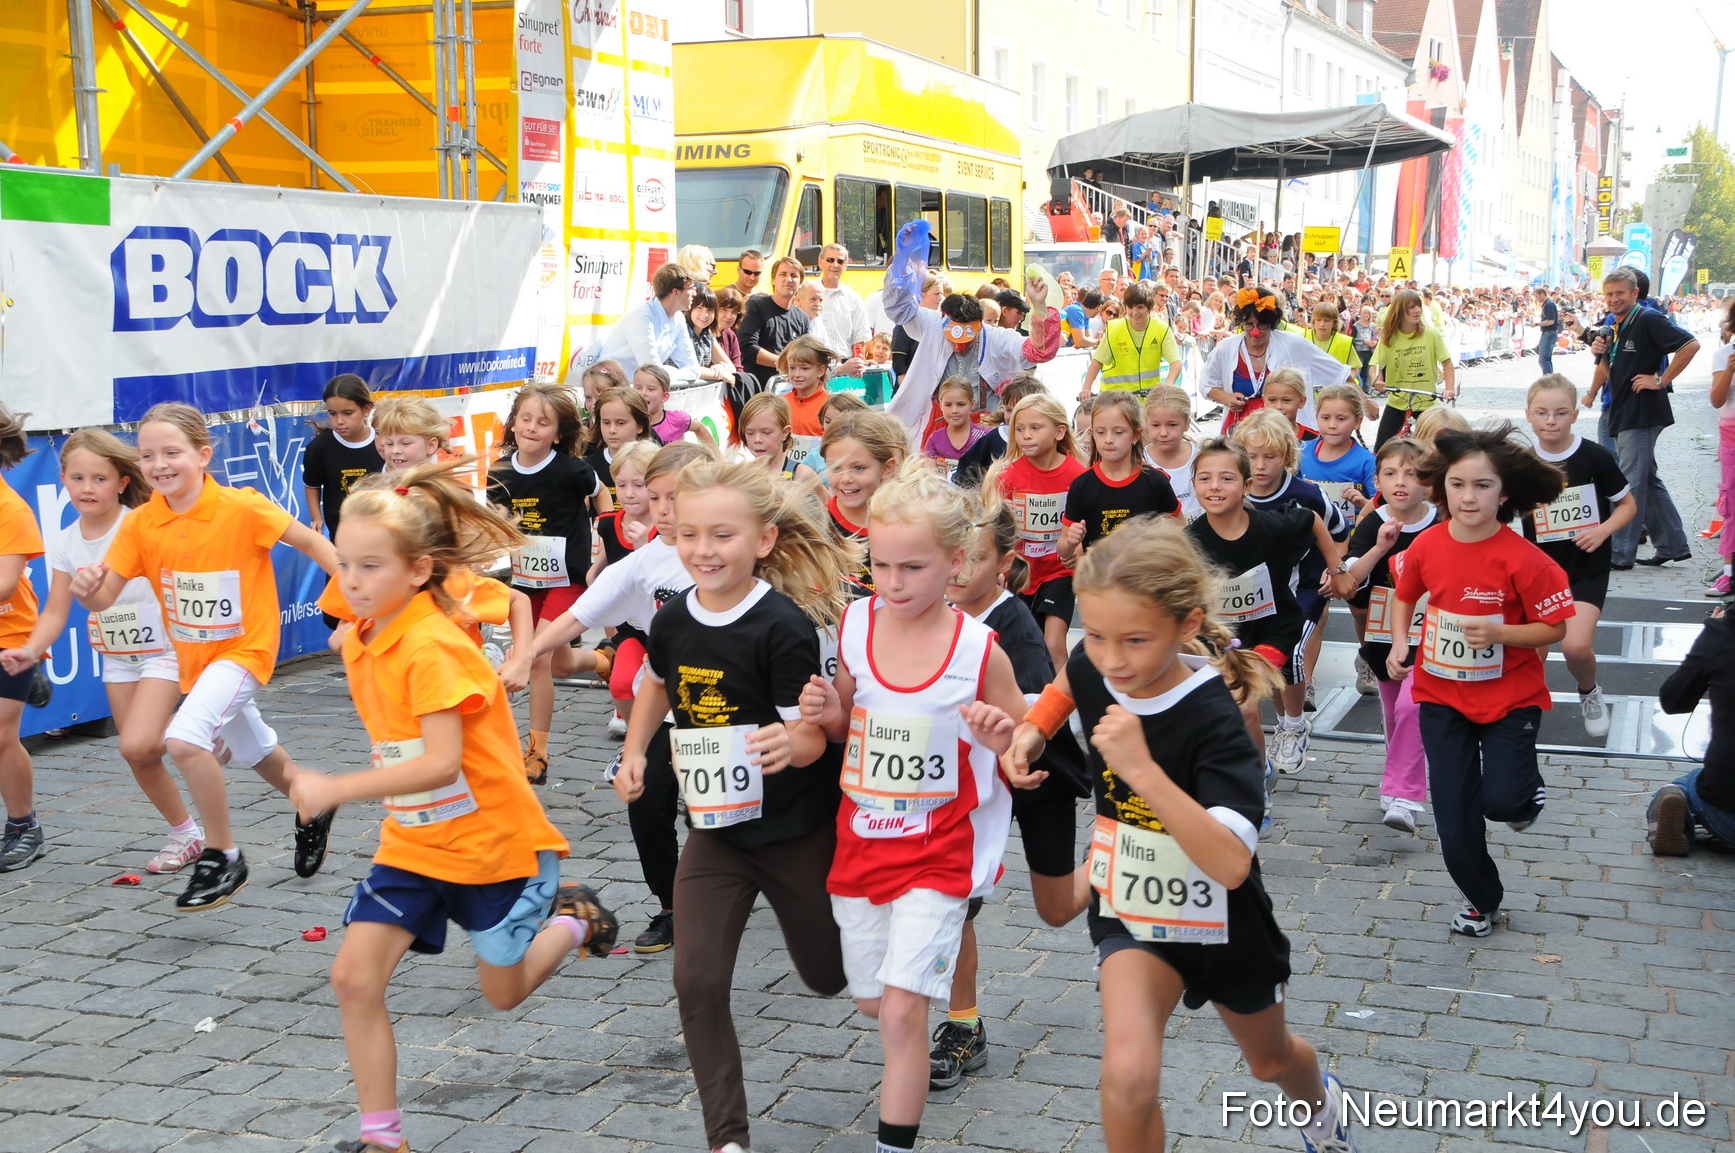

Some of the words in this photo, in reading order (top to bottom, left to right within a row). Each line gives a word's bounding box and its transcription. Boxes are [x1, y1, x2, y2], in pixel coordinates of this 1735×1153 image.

[518, 12, 559, 36] Sinupret
[628, 11, 669, 41] OBI
[518, 34, 542, 54] forte
[532, 73, 564, 87] Egner
[862, 140, 900, 159] SPORTRONIC
[957, 160, 974, 177] EVENT
[975, 163, 995, 180] SERVICE
[574, 255, 623, 279] Sinupret
[1393, 257, 1406, 273] A
[111, 226, 398, 332] BOCK
[573, 280, 602, 299] forte
[1029, 498, 1056, 508] Natalie
[1550, 505, 1592, 523] 7029
[523, 556, 560, 572] 7288
[176, 577, 204, 592] Anika
[180, 598, 232, 618] 7079
[1219, 587, 1265, 609] 7061
[100, 611, 136, 624] Luciana
[105, 626, 155, 646] 7122
[869, 718, 910, 742] Laura
[675, 736, 720, 755] Amelie
[869, 751, 946, 781] 7033
[679, 765, 750, 795] 7019
[867, 816, 905, 830] DEHN
[1121, 833, 1156, 862] Nina
[1092, 859, 1107, 878] K3
[1121, 871, 1213, 908] 7093
